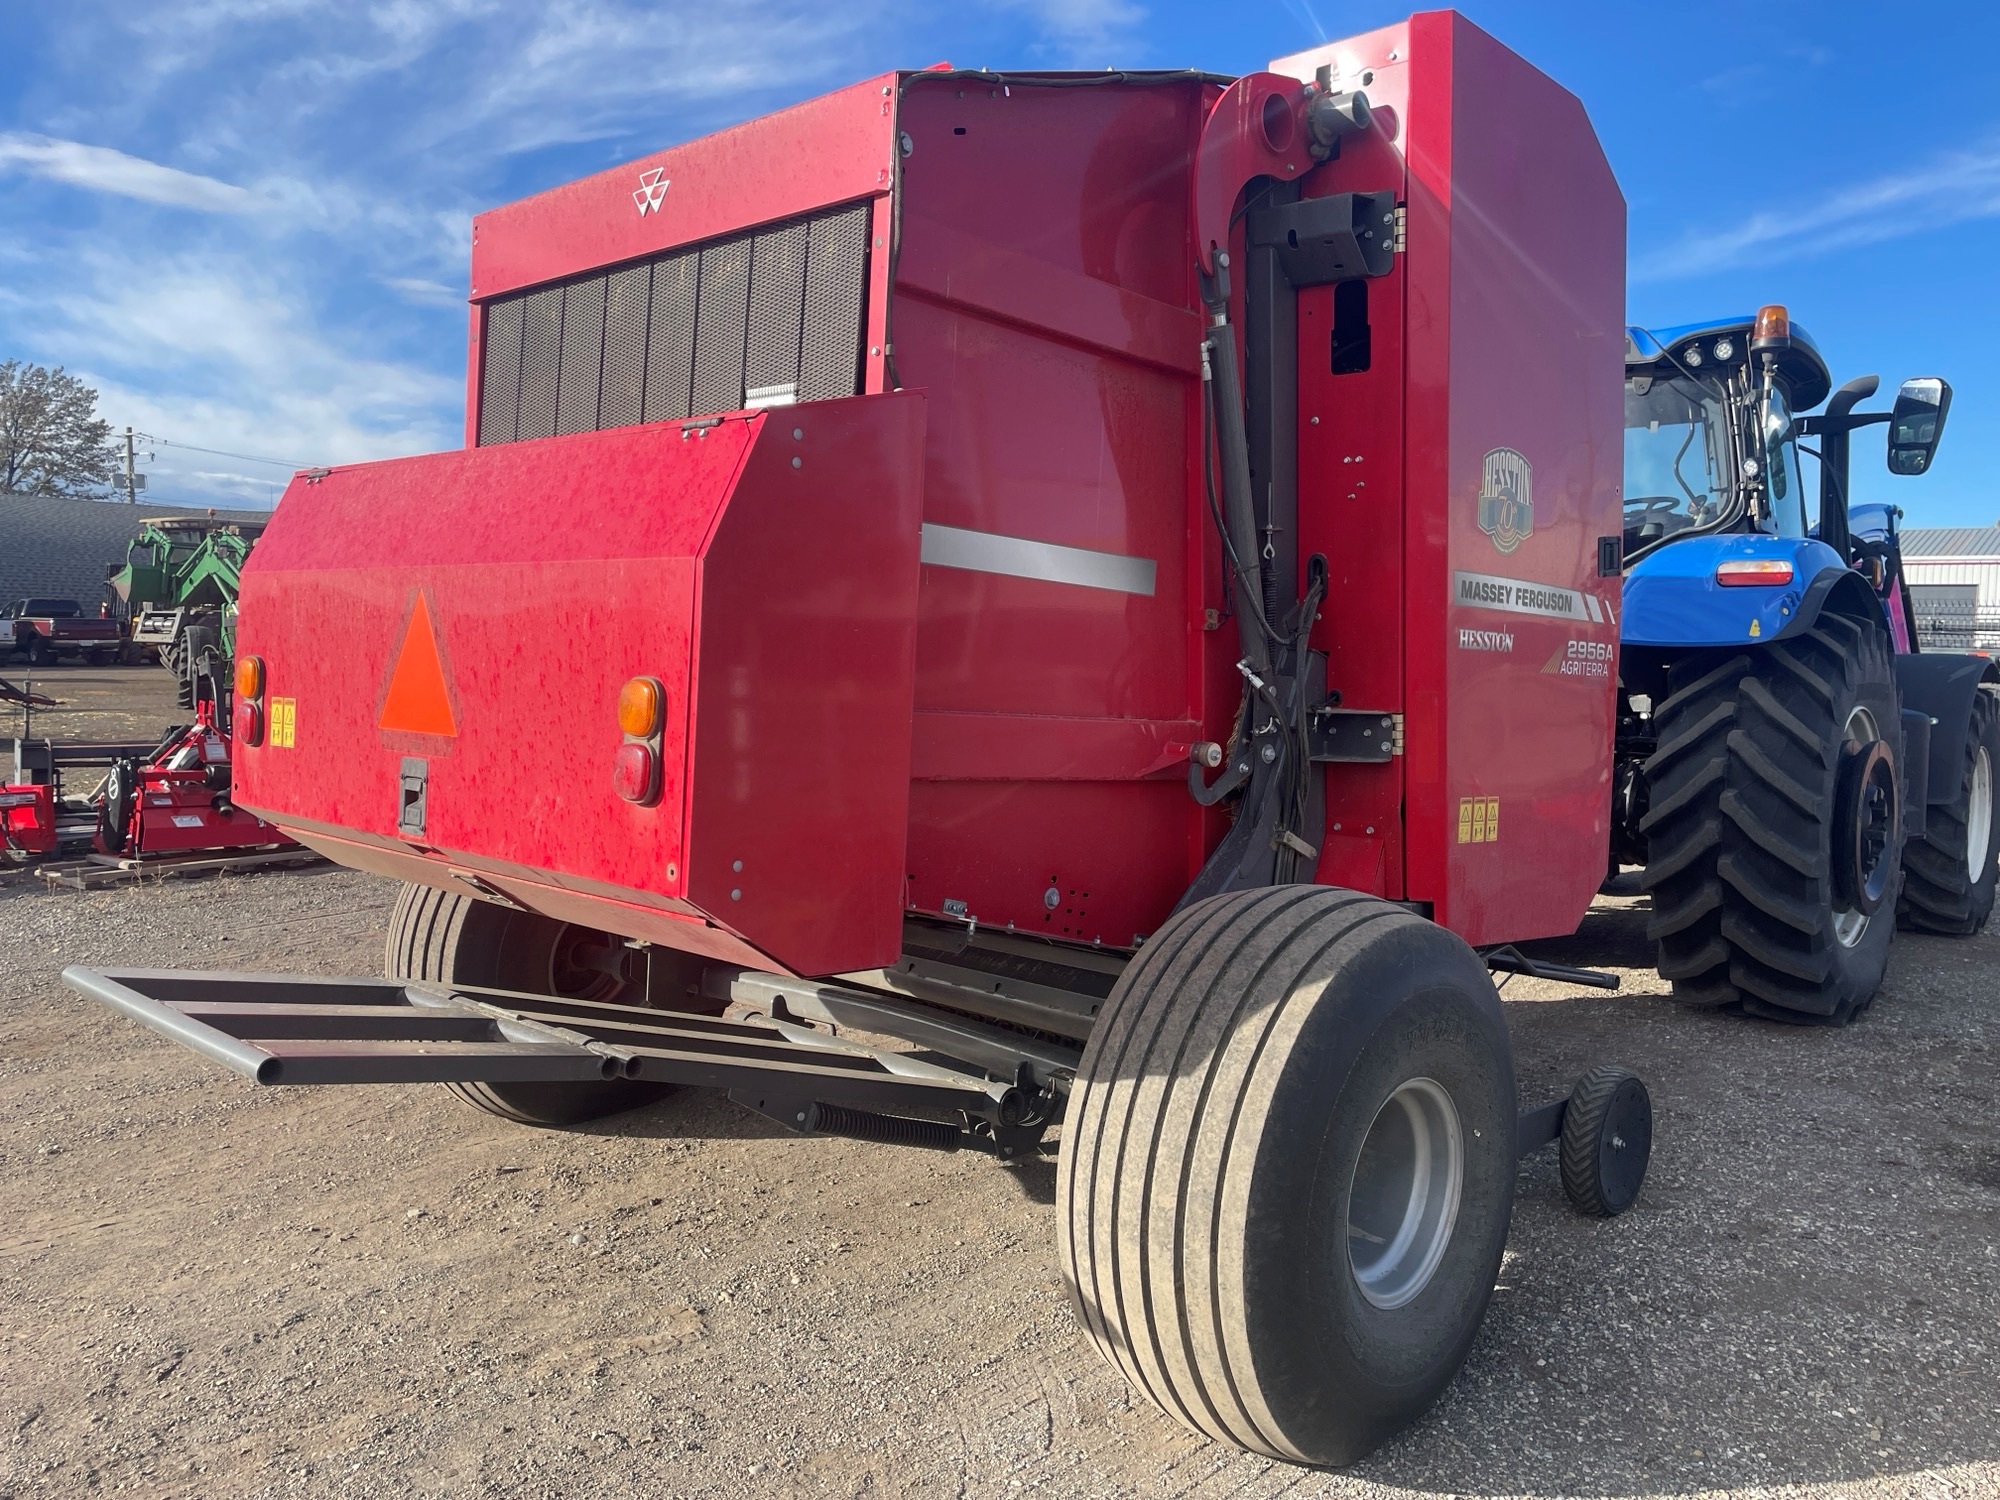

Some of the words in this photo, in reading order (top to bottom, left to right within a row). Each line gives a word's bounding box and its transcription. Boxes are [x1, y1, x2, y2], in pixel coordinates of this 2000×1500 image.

[1484, 451, 1531, 506] HESSTON
[1461, 579, 1513, 605] MASSEY
[1515, 587, 1573, 613] FERGUSON
[1459, 628, 1514, 653] HESSTON
[1567, 640, 1614, 662] 2956A
[1560, 660, 1609, 677] AGRITERRA
